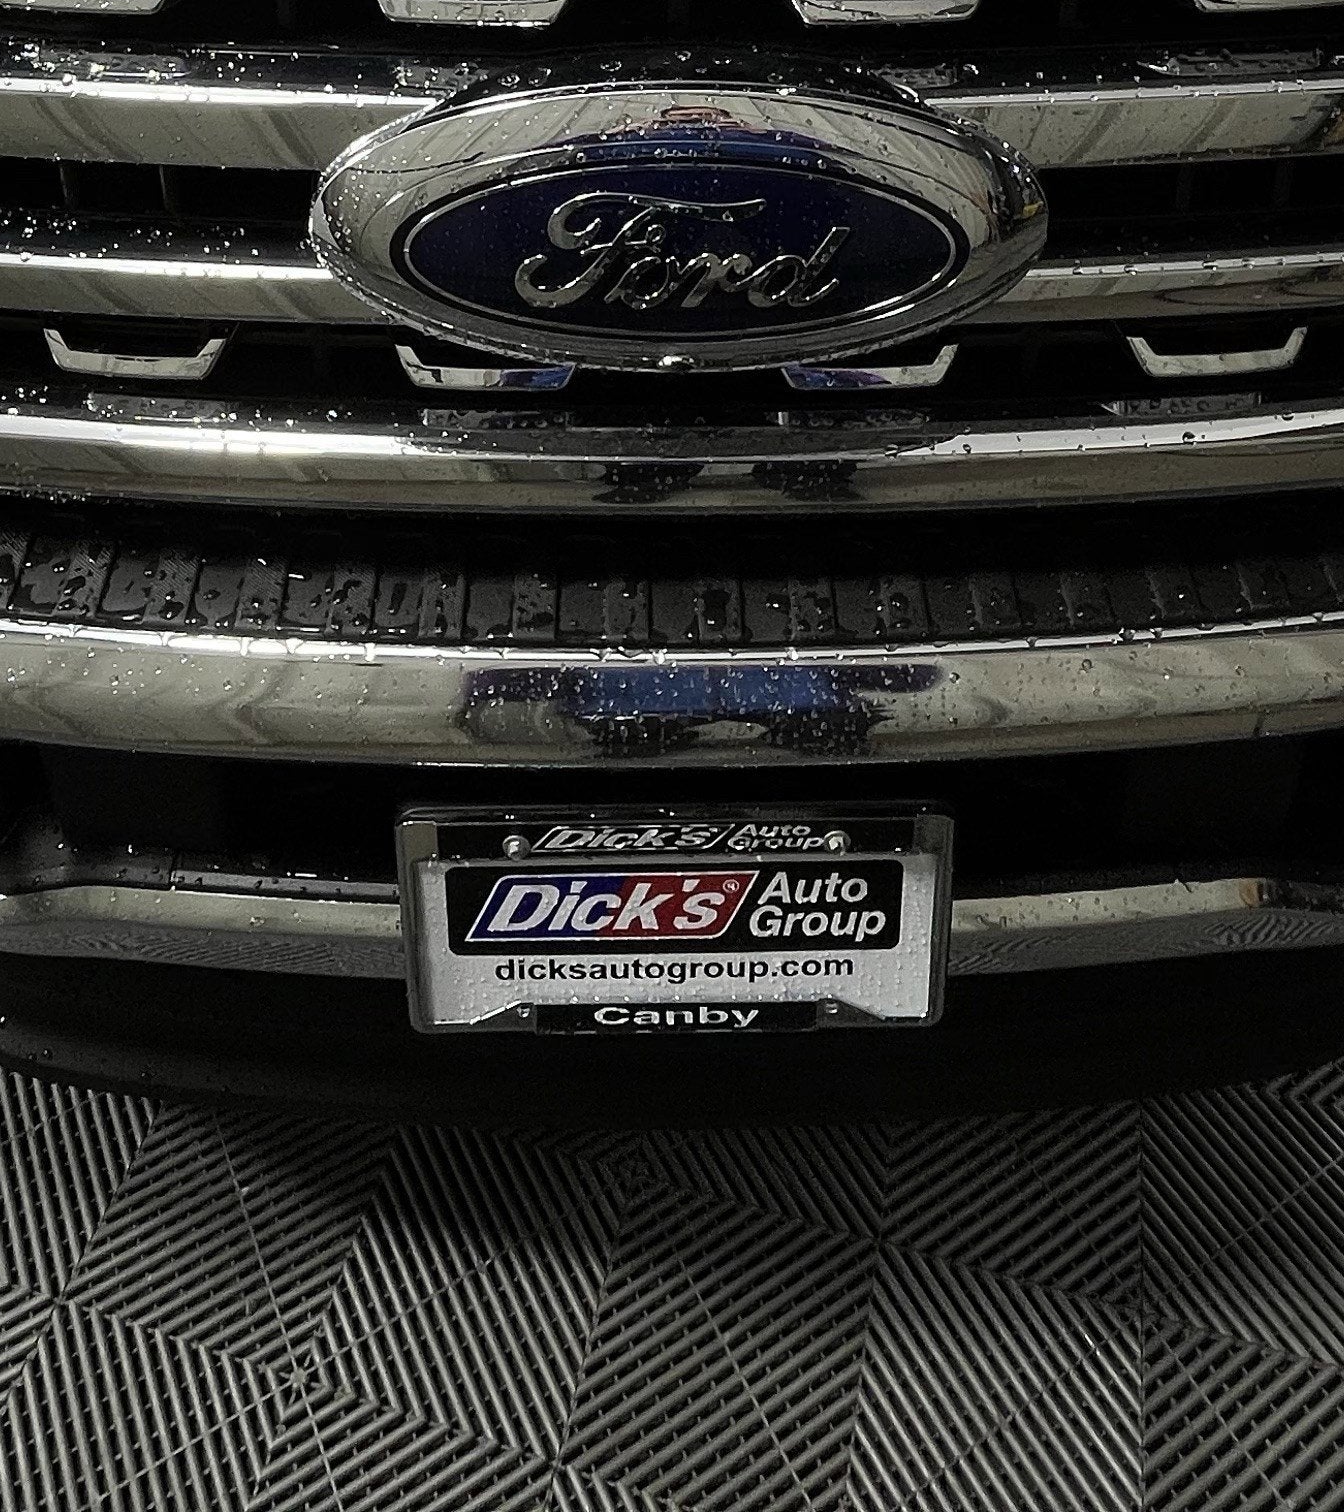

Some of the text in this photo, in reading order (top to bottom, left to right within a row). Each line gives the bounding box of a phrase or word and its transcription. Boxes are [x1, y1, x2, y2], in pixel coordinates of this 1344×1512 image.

[515, 190, 850, 309] Ford
[545, 824, 812, 849] Dick's Auto
[727, 836, 825, 850] Group
[487, 872, 868, 933] Dick's Auto
[749, 904, 886, 942] Group
[494, 957, 855, 984] dicksautogroup.com
[593, 1006, 760, 1029] Canby
